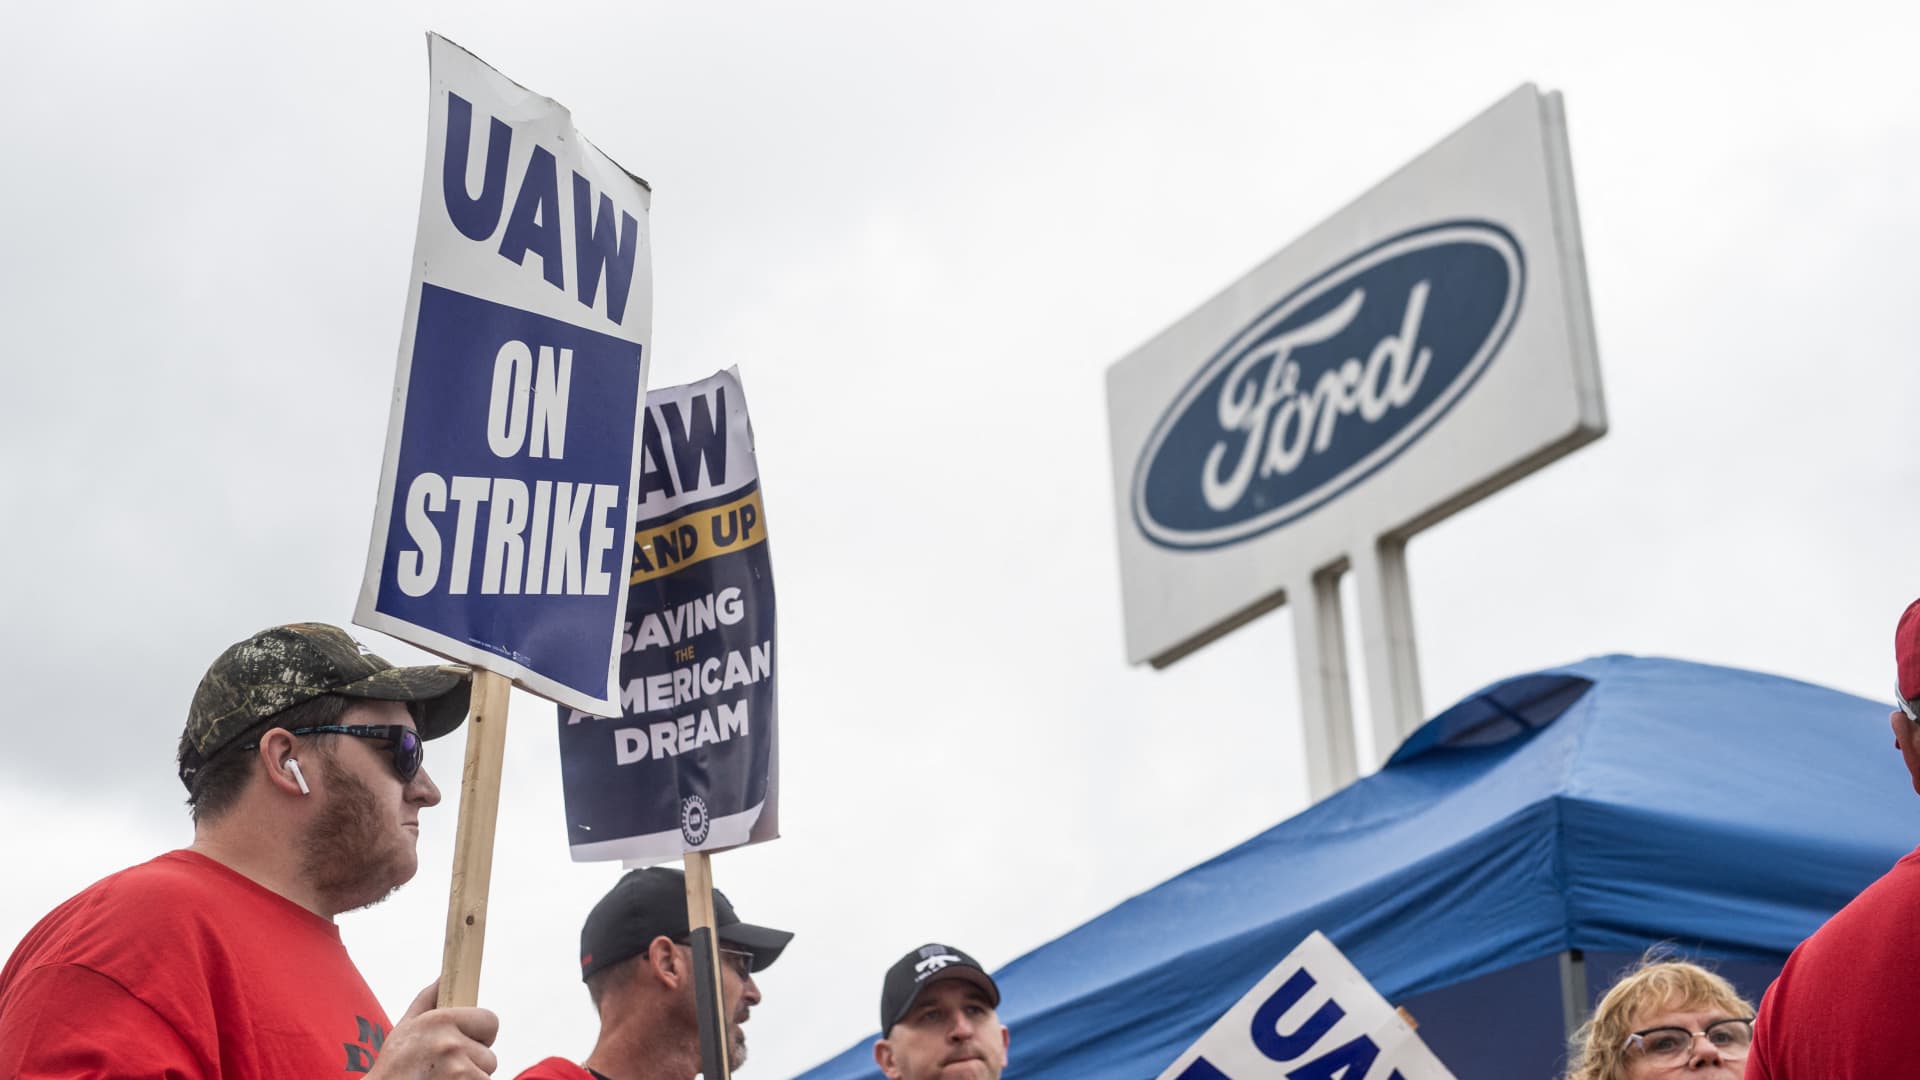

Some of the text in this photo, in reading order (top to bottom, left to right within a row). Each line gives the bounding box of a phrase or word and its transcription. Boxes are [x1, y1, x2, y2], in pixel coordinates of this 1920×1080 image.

[443, 90, 638, 326] UAW
[487, 340, 573, 459] ON
[638, 386, 727, 505] AW
[1203, 279, 1432, 511] Ford
[398, 472, 619, 597] STRIKE
[630, 503, 756, 577] AND UP
[568, 641, 771, 725] MERICAN
[674, 645, 695, 663] THE
[614, 699, 749, 766] DREAM
[1251, 966, 1405, 1080] UA
